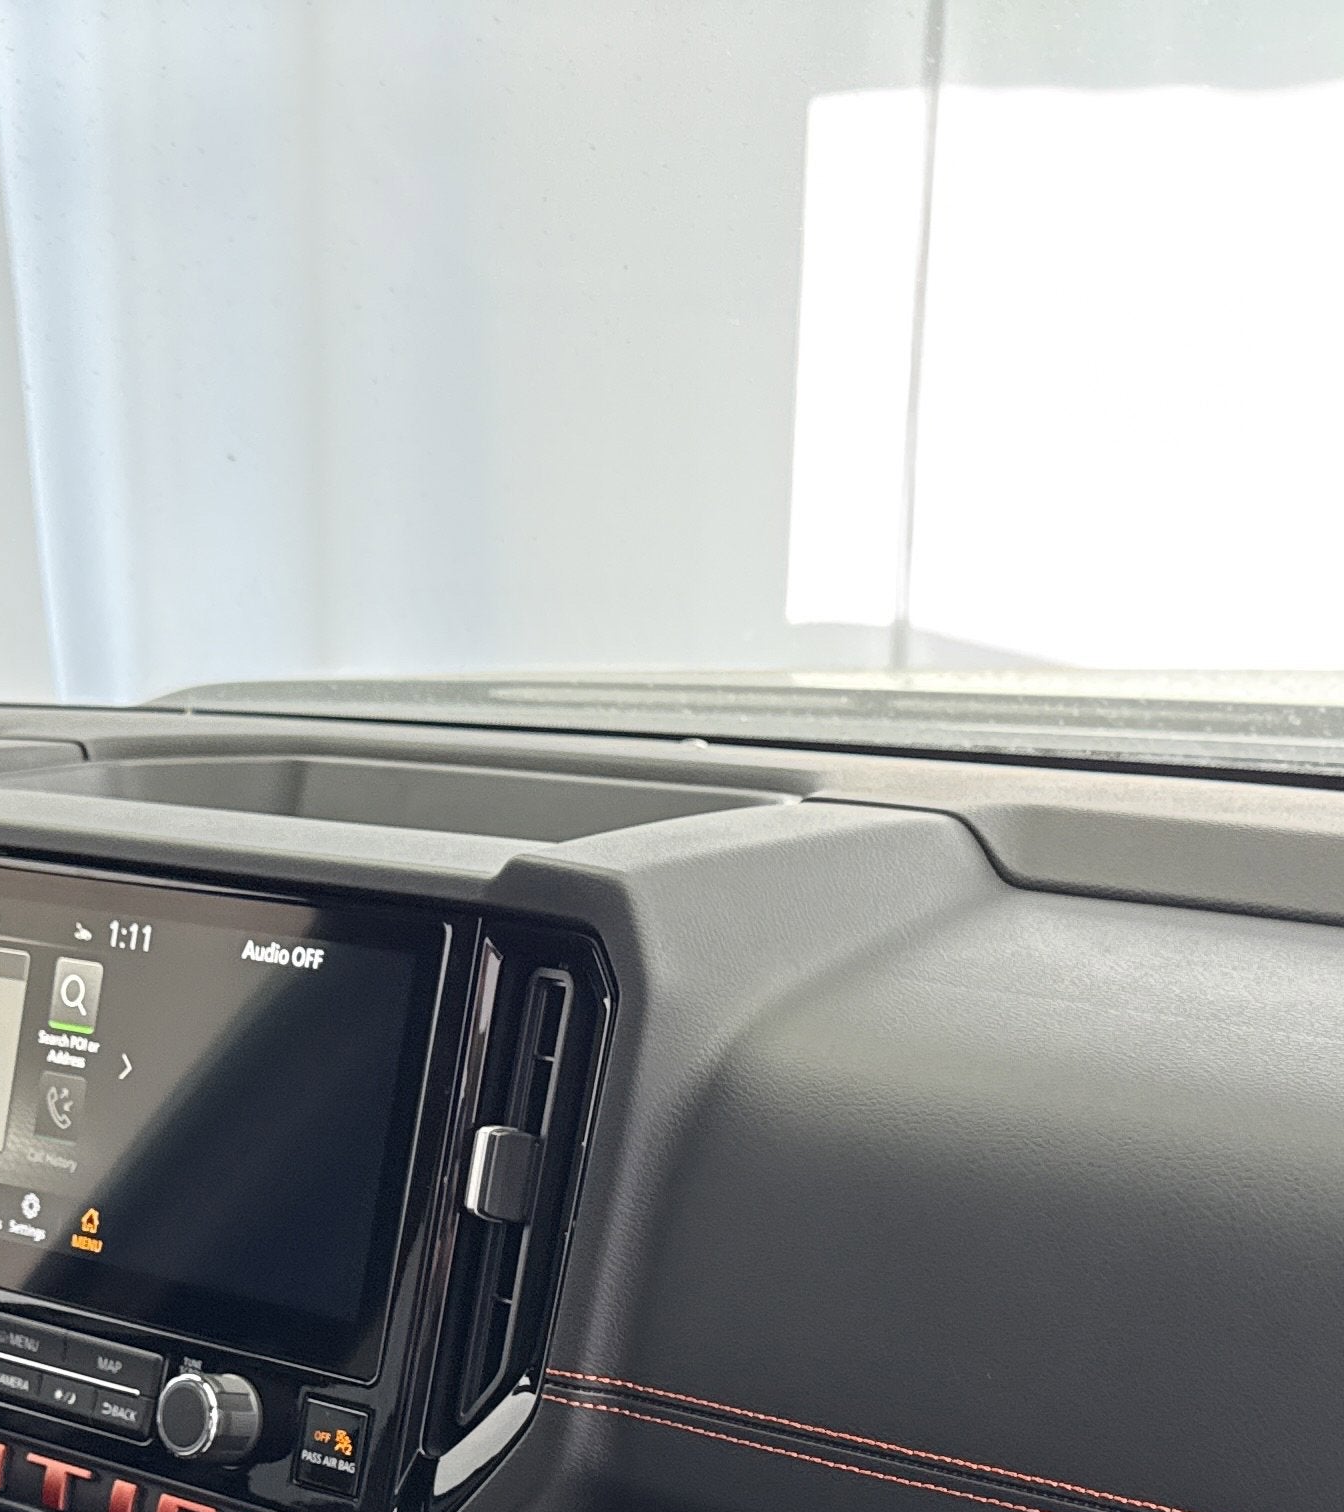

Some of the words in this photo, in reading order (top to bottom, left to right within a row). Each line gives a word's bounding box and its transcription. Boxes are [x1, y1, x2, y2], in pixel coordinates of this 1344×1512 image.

[109, 920, 153, 952] 1:11
[241, 940, 290, 966] Audio
[291, 946, 325, 969] OFF
[37, 1030, 70, 1048] Search
[70, 1035, 88, 1051] POI
[87, 1041, 101, 1053] or
[46, 1049, 86, 1068] Address
[8, 1219, 47, 1242] Settings
[71, 1234, 103, 1253] MENU
[9, 1331, 40, 1352] MENU
[97, 1356, 123, 1374] MAP
[110, 1403, 138, 1422] BACK
[314, 1430, 332, 1443] OFF
[301, 1449, 322, 1465] PASS
[322, 1456, 338, 1469] AIR
[338, 1459, 356, 1474] BAG
